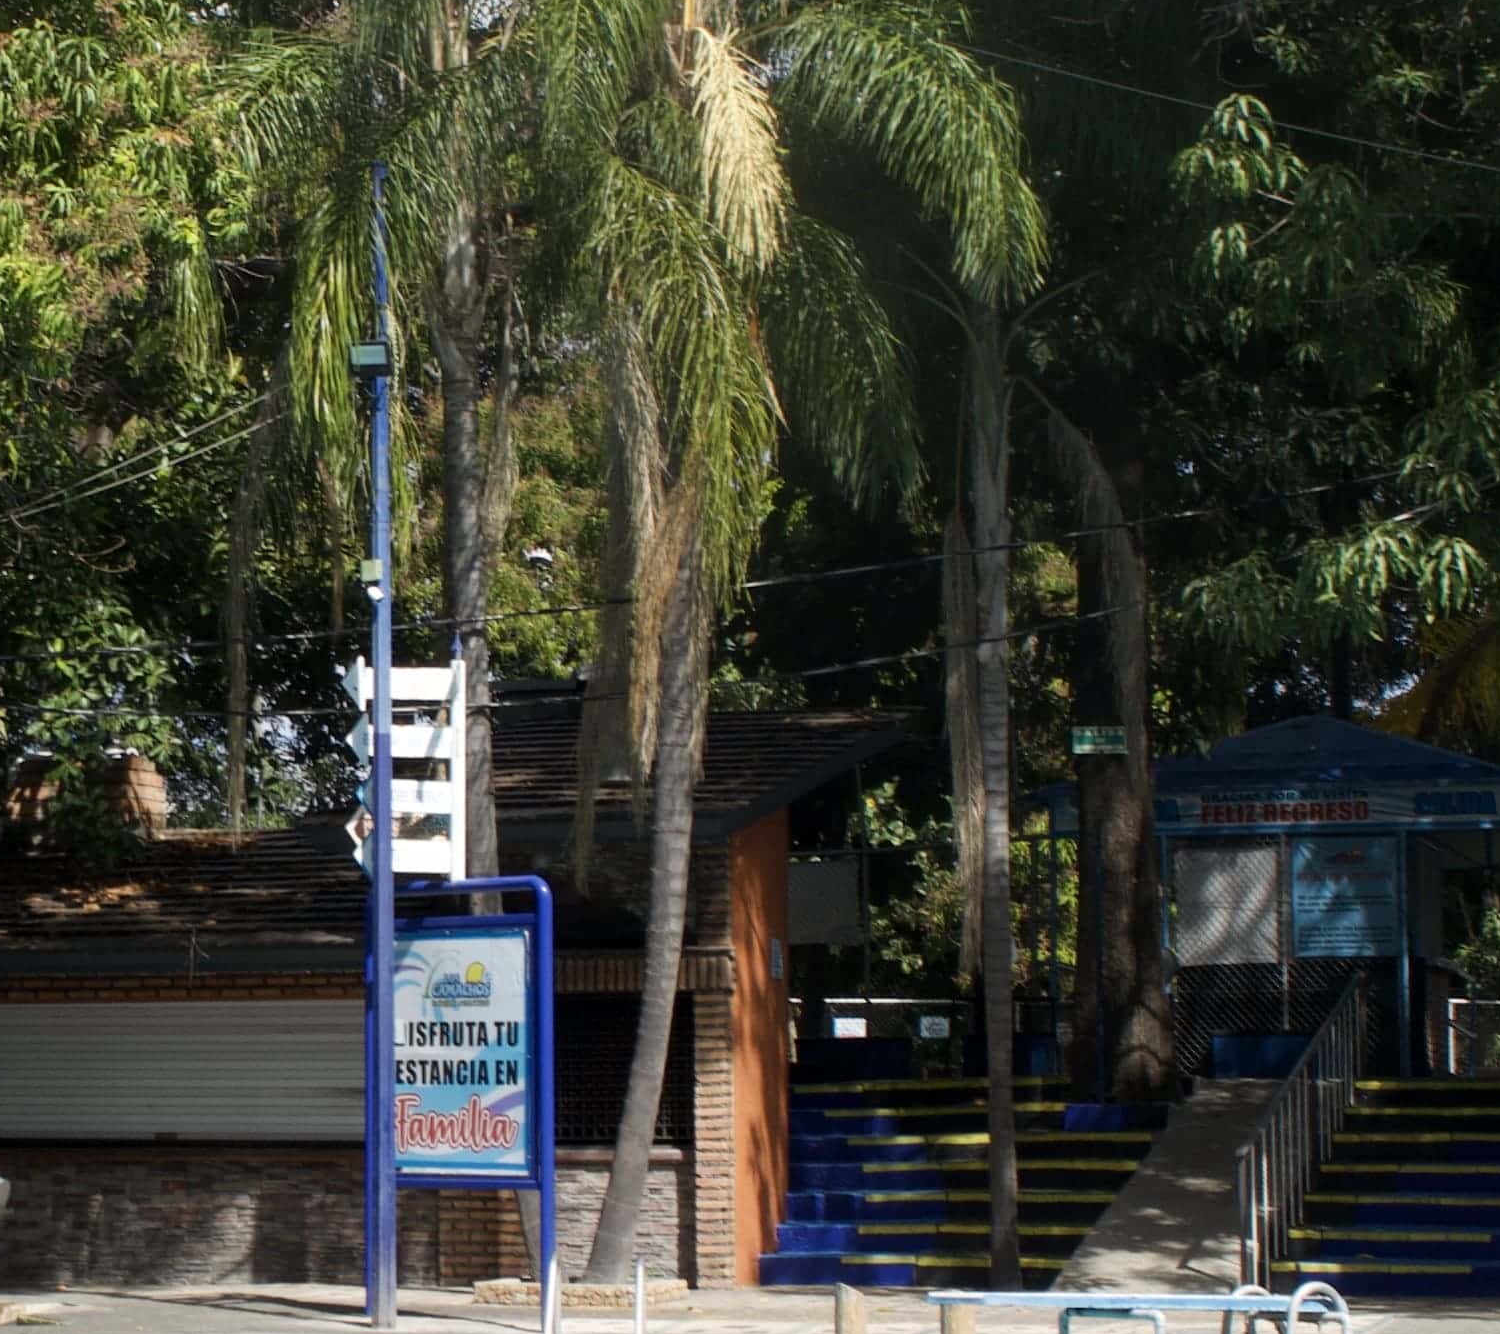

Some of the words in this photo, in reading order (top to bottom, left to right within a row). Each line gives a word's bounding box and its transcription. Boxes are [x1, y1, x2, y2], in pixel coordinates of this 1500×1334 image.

[1201, 803, 1256, 825] FELIZ
[1264, 800, 1369, 822] REGRESO
[494, 1021, 519, 1047] TU
[396, 1059, 489, 1085] ESTANCIA
[496, 1059, 518, 1085] EN
[394, 1093, 519, 1154] Familia
